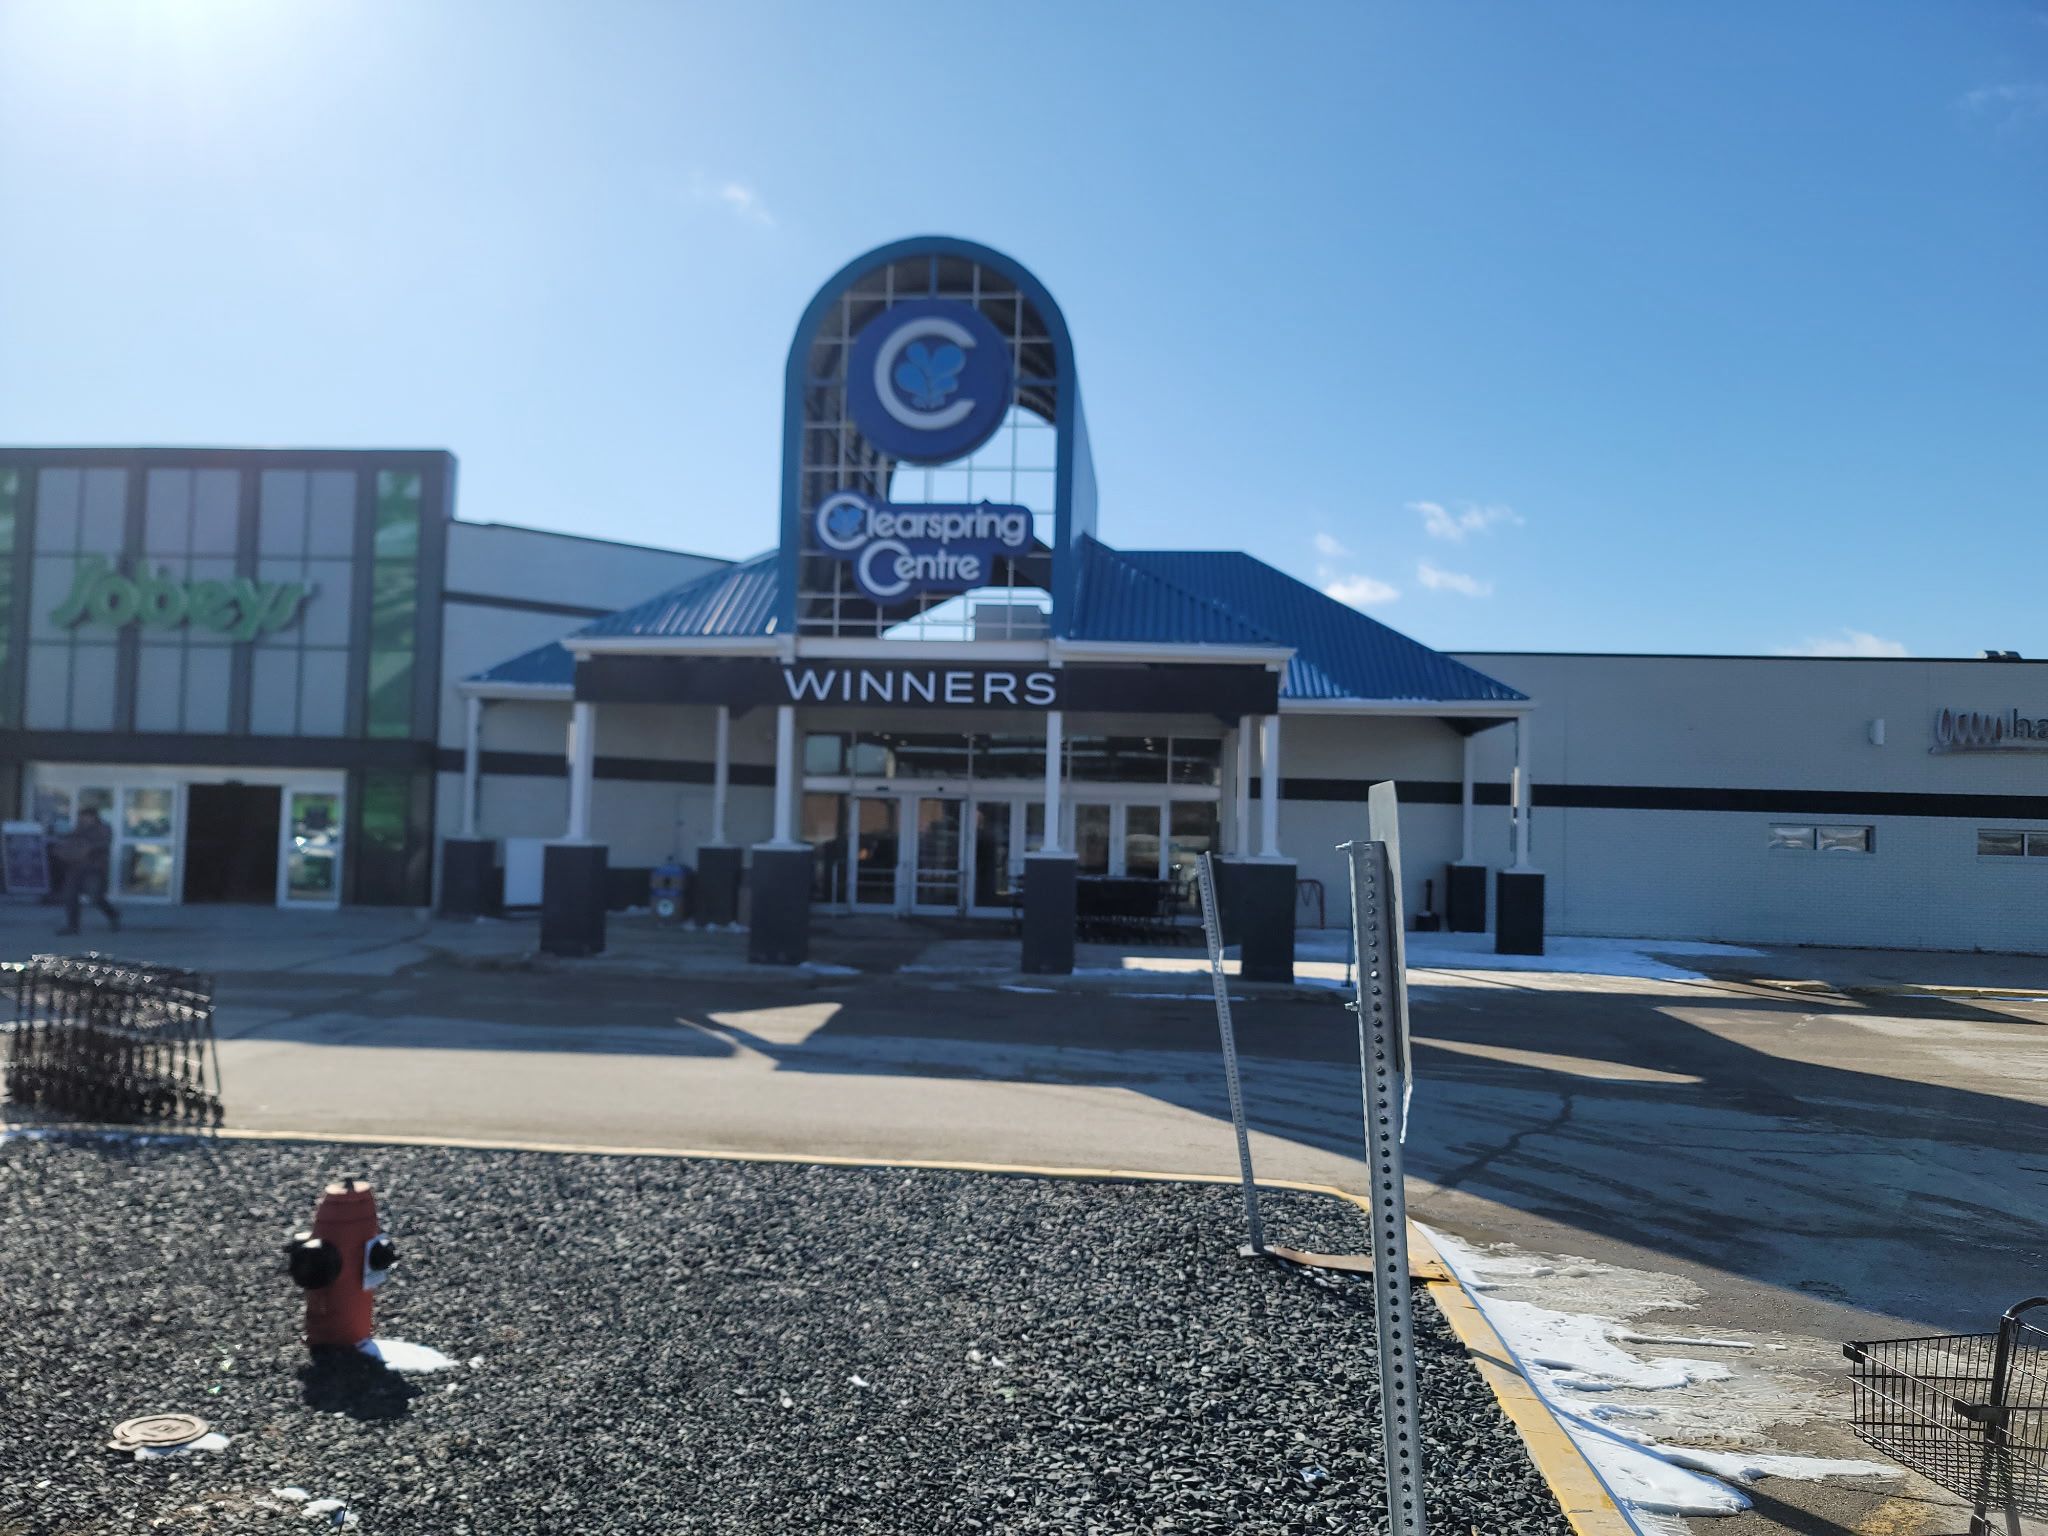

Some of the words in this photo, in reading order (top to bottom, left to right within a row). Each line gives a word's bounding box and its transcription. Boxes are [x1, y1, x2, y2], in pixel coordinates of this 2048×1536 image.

[817, 492, 1026, 547] Clearspring
[859, 540, 980, 596] Centre
[784, 669, 1057, 705] WINNERS
